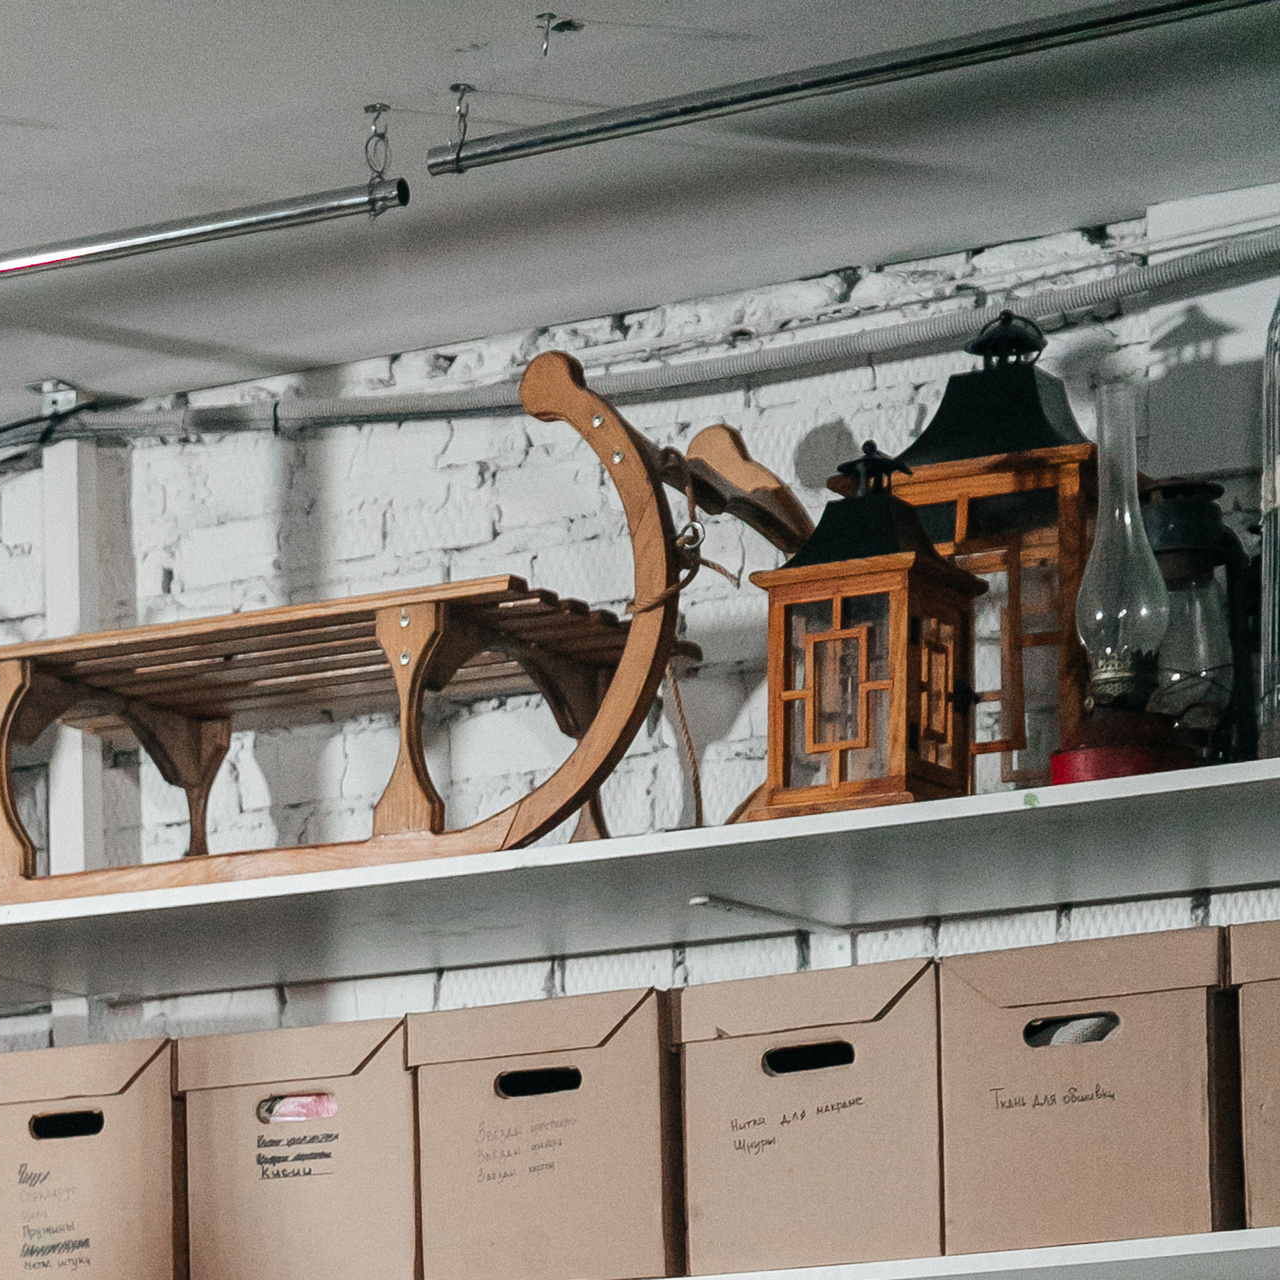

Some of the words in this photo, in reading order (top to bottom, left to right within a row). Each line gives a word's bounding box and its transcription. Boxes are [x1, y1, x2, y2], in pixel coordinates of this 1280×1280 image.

[989, 1087, 1027, 1110] Ткань
[1032, 1093, 1058, 1110] для
[1062, 1081, 1116, 1105] обшивки
[730, 1117, 767, 1132] Нитки
[780, 1109, 807, 1127] для
[816, 1096, 866, 1115] макраме
[733, 1137, 777, 1156] Шнуры
